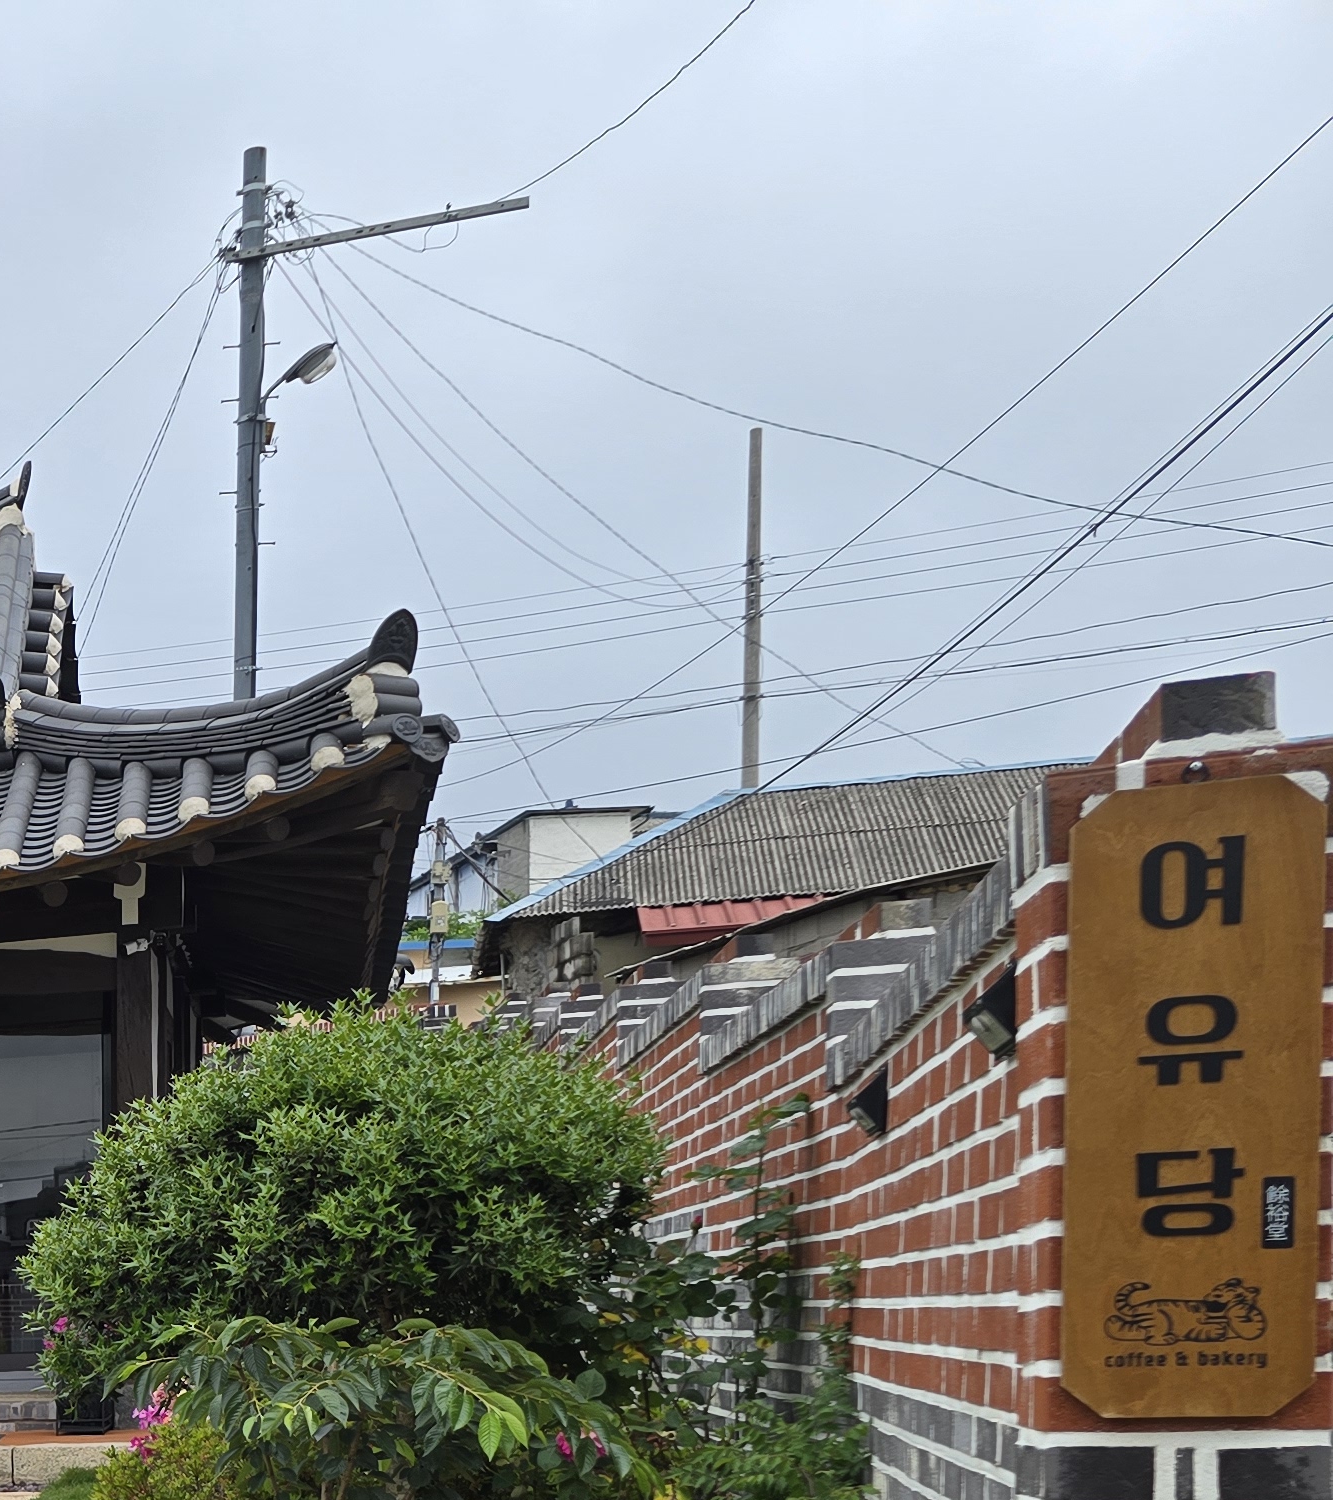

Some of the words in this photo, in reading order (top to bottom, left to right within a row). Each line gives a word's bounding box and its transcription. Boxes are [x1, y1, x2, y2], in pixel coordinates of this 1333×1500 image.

[1136, 834, 1247, 1238] 여유당
[1264, 1184, 1290, 1241] 餘裕堂
[1104, 1352, 1167, 1368] coffee
[1175, 1351, 1188, 1366] &
[1197, 1350, 1269, 1368] bakery
